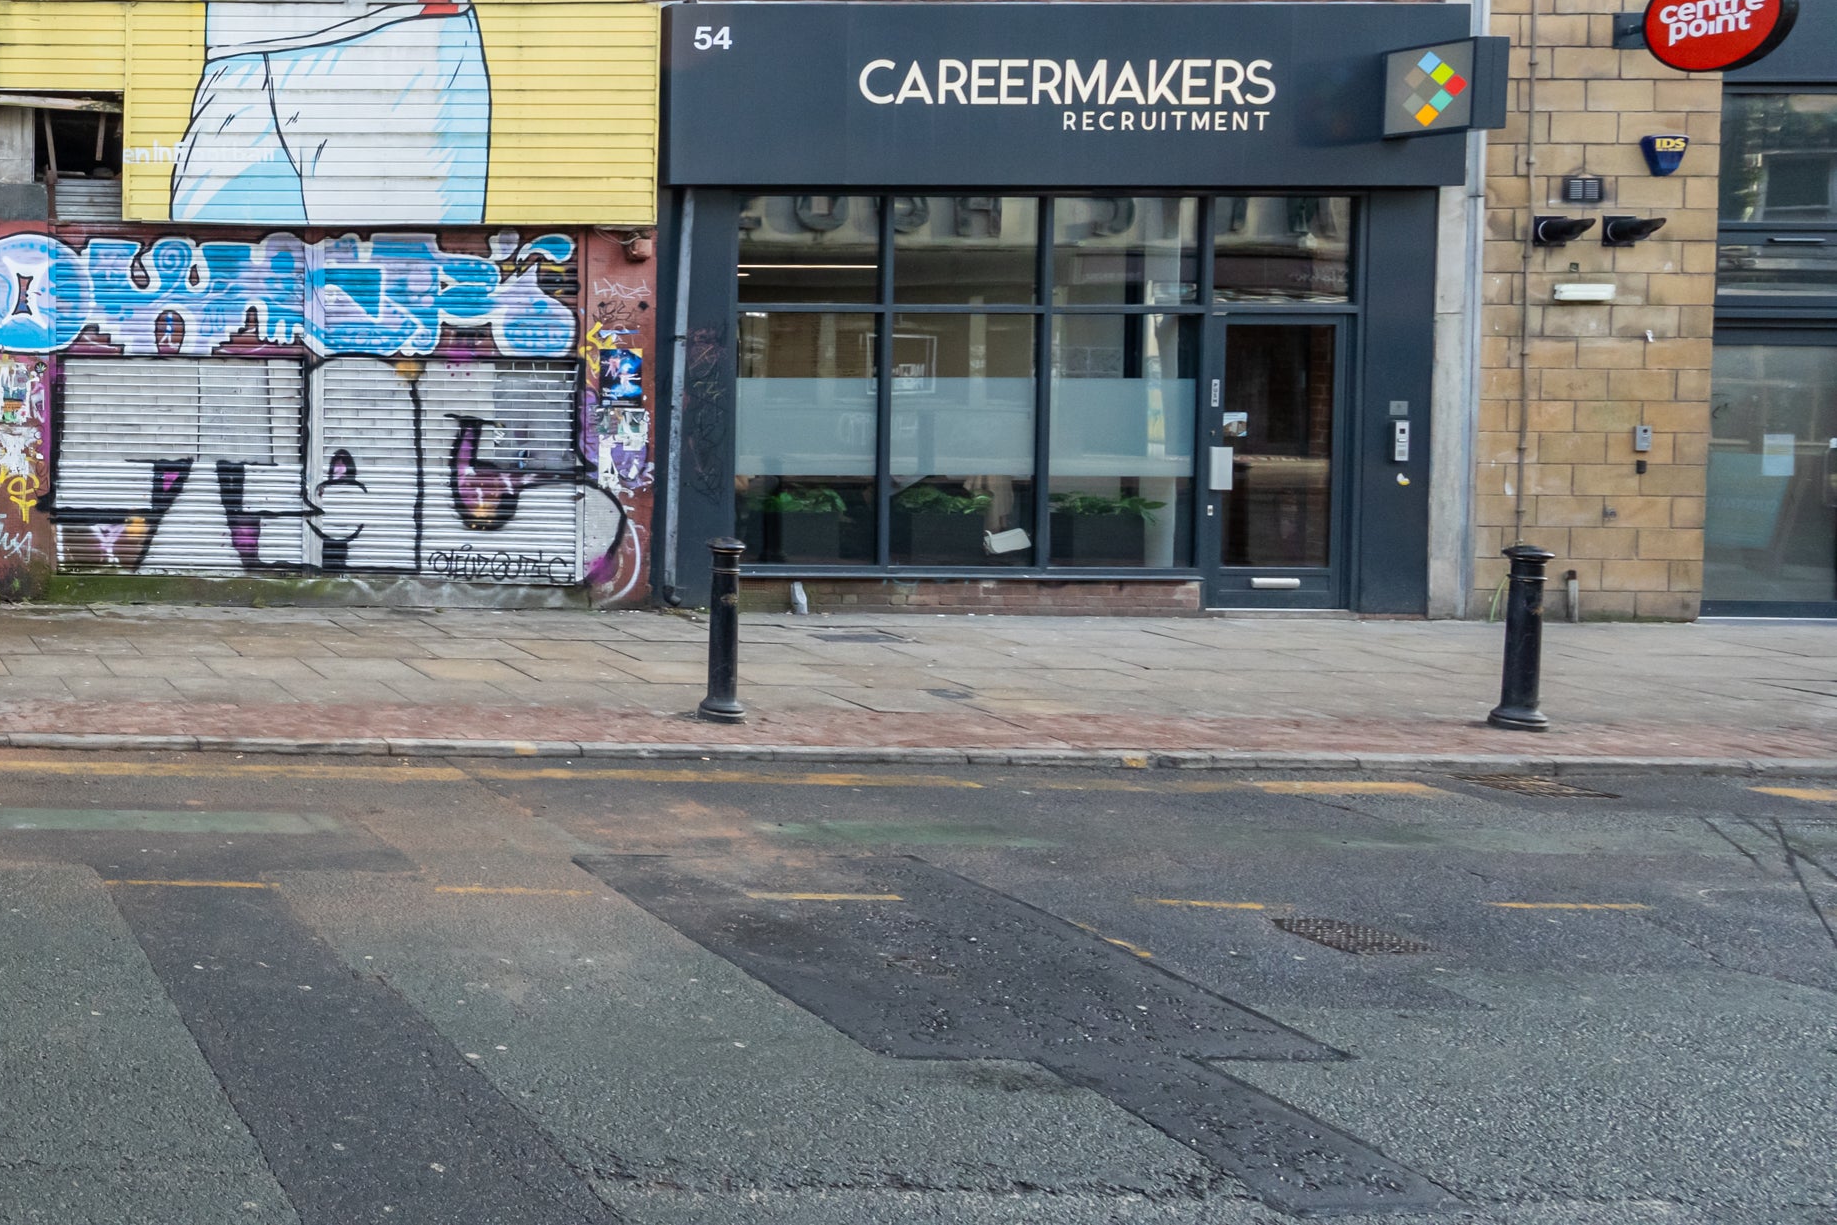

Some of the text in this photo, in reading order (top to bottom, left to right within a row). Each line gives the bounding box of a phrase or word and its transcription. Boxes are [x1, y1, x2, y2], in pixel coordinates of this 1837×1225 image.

[693, 26, 733, 51] 54
[1668, 9, 1752, 47] point
[858, 58, 1277, 106] CAREERMAKERS
[1063, 111, 1271, 132] RECRUITMENT
[1655, 137, 1686, 149] IDS
